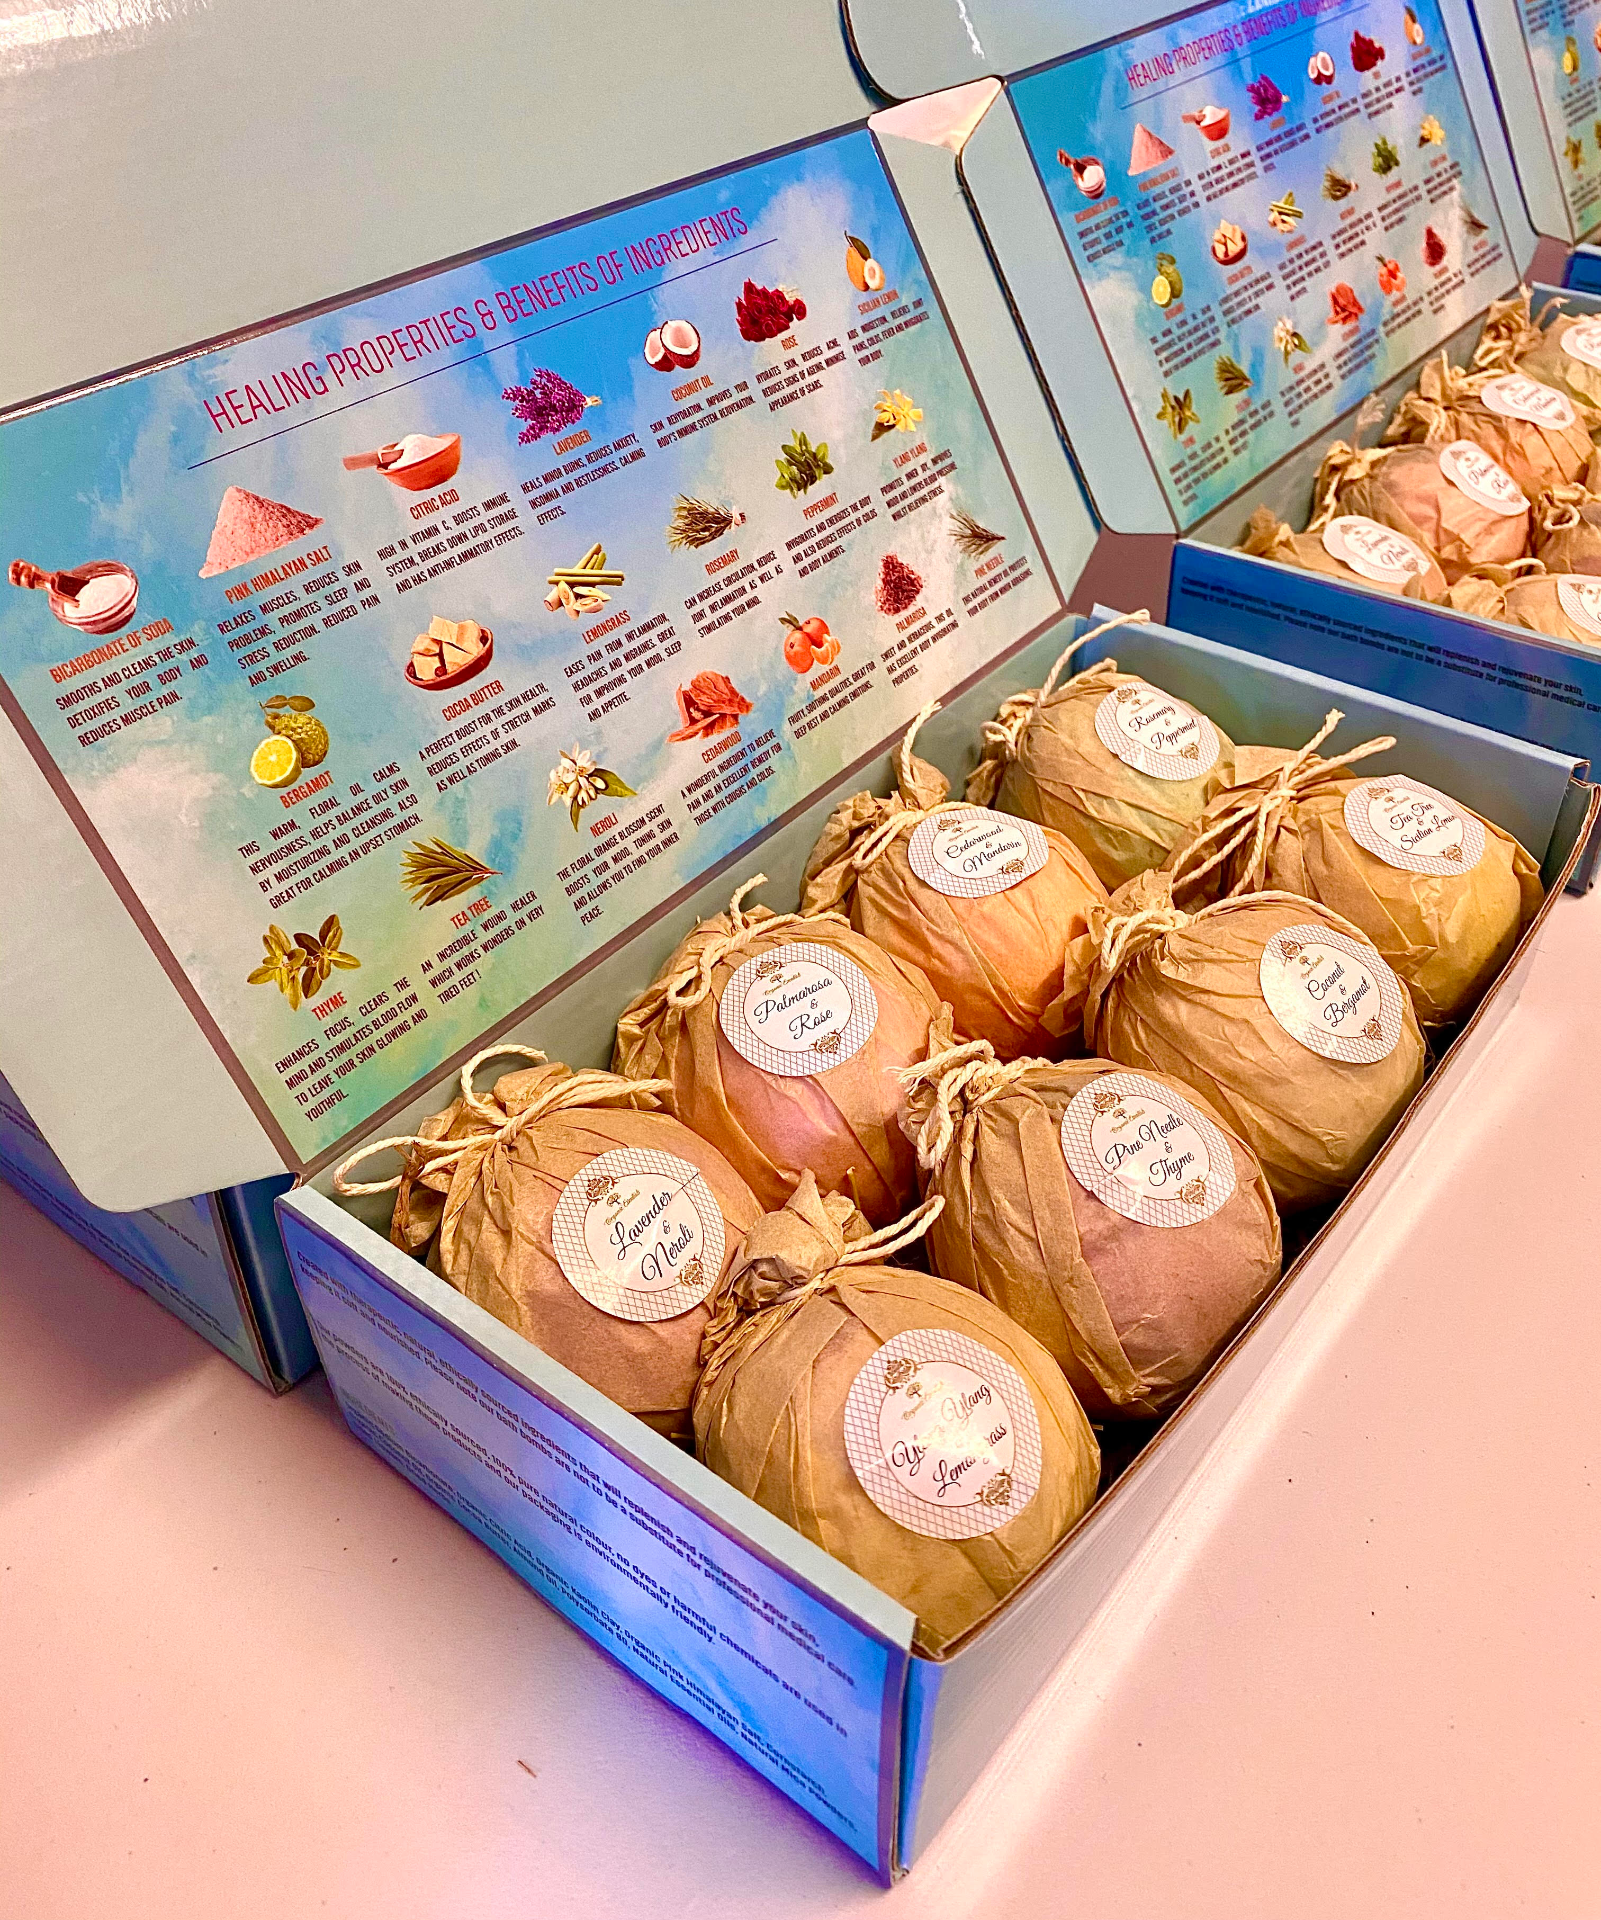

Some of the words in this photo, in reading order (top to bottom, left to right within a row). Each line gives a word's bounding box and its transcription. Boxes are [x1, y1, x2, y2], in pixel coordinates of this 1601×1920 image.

[1124, 52, 1175, 90] HEALING
[1171, 27, 1235, 68] PROPERTIES
[879, 289, 900, 306] LEMON
[203, 361, 329, 433] HEALING
[325, 306, 477, 387] PROPERTIES
[474, 299, 497, 331] &
[494, 261, 599, 324] BENEFITS
[596, 250, 624, 286] OF
[623, 207, 748, 275] INGREDIENTS
[780, 334, 799, 351] ROSE
[671, 378, 703, 402] COCONUT
[700, 374, 714, 389] OIL
[552, 429, 592, 456] LAVENDER
[892, 451, 912, 469] YLANG
[909, 442, 928, 459] YLANG
[520, 476, 543, 495] HEALS
[541, 467, 564, 485] MINOR
[562, 457, 587, 475] BURNS,
[584, 444, 614, 465] REDUCES
[612, 432, 640, 453] ANXIETY,
[528, 488, 561, 510] INSOMNIA
[560, 481, 576, 496] AND
[618, 447, 646, 467] CALMING
[409, 497, 440, 520] CITRIC
[437, 488, 460, 508] ACID
[536, 505, 567, 526] EFFECTS.
[802, 492, 839, 521] PEPPERMINT
[224, 581, 254, 604] PINK
[250, 556, 309, 592] HIMALAYAN
[306, 545, 332, 567] SALT
[704, 548, 740, 576] ROSEMARY
[974, 564, 988, 580] PINE
[984, 553, 1005, 572] NEEDLE
[581, 609, 631, 645] LEMONGRASS
[895, 606, 927, 634] PALMAROSA
[49, 637, 130, 684] BICARBONATE
[126, 630, 142, 648] OF
[141, 617, 174, 641] SODA
[55, 681, 102, 711] SMOOTHS
[100, 671, 123, 690] AND
[120, 655, 158, 680] CLEANS
[154, 646, 176, 663] THE
[173, 636, 199, 655] SKIN.
[66, 695, 121, 730] DETOXIFIES
[124, 680, 153, 700] YOUR
[156, 665, 183, 686] BODY
[189, 653, 209, 671] AND
[809, 664, 842, 692] MANDARIN
[77, 718, 122, 748] REDUCES
[119, 700, 158, 727] MUSCLE
[156, 689, 183, 709] PAIN.
[441, 697, 473, 722] COCOA
[469, 679, 505, 706] BUTTER
[418, 750, 427, 762] A
[424, 732, 456, 758] PERFECT
[454, 719, 479, 741] BOOST
[476, 712, 494, 728] FOR
[490, 704, 507, 720] THE
[504, 695, 523, 713] SKIN
[520, 682, 549, 704] HEALTH,
[426, 751, 460, 777] REDUCES
[459, 734, 491, 759] EFFECTS
[490, 727, 501, 741] OF
[501, 710, 533, 734] STRETCH
[531, 696, 556, 717] MARKS
[1128, 705, 1176, 733] Rosemary
[1150, 717, 1198, 750] Peppermint
[436, 779, 448, 793] AS
[445, 768, 468, 786] WELL
[465, 762, 478, 776] AS
[474, 747, 503, 770] TONING
[500, 737, 521, 755] SKIN.
[701, 730, 742, 764] CEDARWOOD
[279, 770, 334, 809] BERGAMOT
[589, 812, 619, 838] NEROLI
[944, 825, 1004, 859] Cedarwood
[1400, 826, 1434, 851] Sicilian
[962, 841, 1022, 873] Mandarin
[450, 910, 471, 930] TEA
[467, 895, 492, 918] TREE
[420, 959, 434, 974] AN
[436, 929, 478, 963] INCREDIBLE
[480, 909, 508, 933] WOUND
[509, 890, 538, 914] HEALER
[428, 966, 455, 989] WHICH
[453, 948, 482, 972] WORKS
[480, 925, 516, 954] WONDERS
[514, 917, 527, 931] ON
[526, 904, 545, 923] VERY
[437, 984, 461, 1005] TIRED
[458, 971, 477, 991] FEET
[1304, 961, 1345, 1001] Coconut
[1339, 983, 1347, 995] &
[311, 991, 348, 1021] THYME
[753, 977, 833, 1024] Palmarosa
[810, 998, 819, 1010] &
[1323, 976, 1371, 1028] Bergamot
[788, 1009, 833, 1040] Rose
[1104, 1138, 1144, 1171] Pine
[1138, 1113, 1184, 1143] Needle
[1164, 1141, 1173, 1154] &
[1148, 1151, 1195, 1187] Thyme
[609, 1190, 673, 1260] Lavender
[662, 1220, 671, 1235] &
[641, 1223, 695, 1281] Neroli
[941, 1384, 992, 1431] Ylang
[520, 1417, 578, 1467] ingredients
[578, 1461, 601, 1484] that
[602, 1479, 622, 1500] will
[623, 1495, 674, 1539] replenish
[675, 1535, 697, 1556] and
[698, 1552, 760, 1603] rejuvenate
[491, 1454, 517, 1479] 100%
[517, 1475, 540, 1498] pure
[541, 1494, 578, 1528] natural
[579, 1523, 615, 1557] colour,
[616, 1552, 630, 1567] no
[632, 1564, 658, 1589] dyes
[673, 1595, 717, 1635] harmful
[719, 1632, 780, 1683] chemicals
[503, 1475, 519, 1492] our
[521, 1488, 573, 1535] packaging
[584, 1538, 669, 1609] environmentally
[671, 1604, 713, 1643] friendly.
